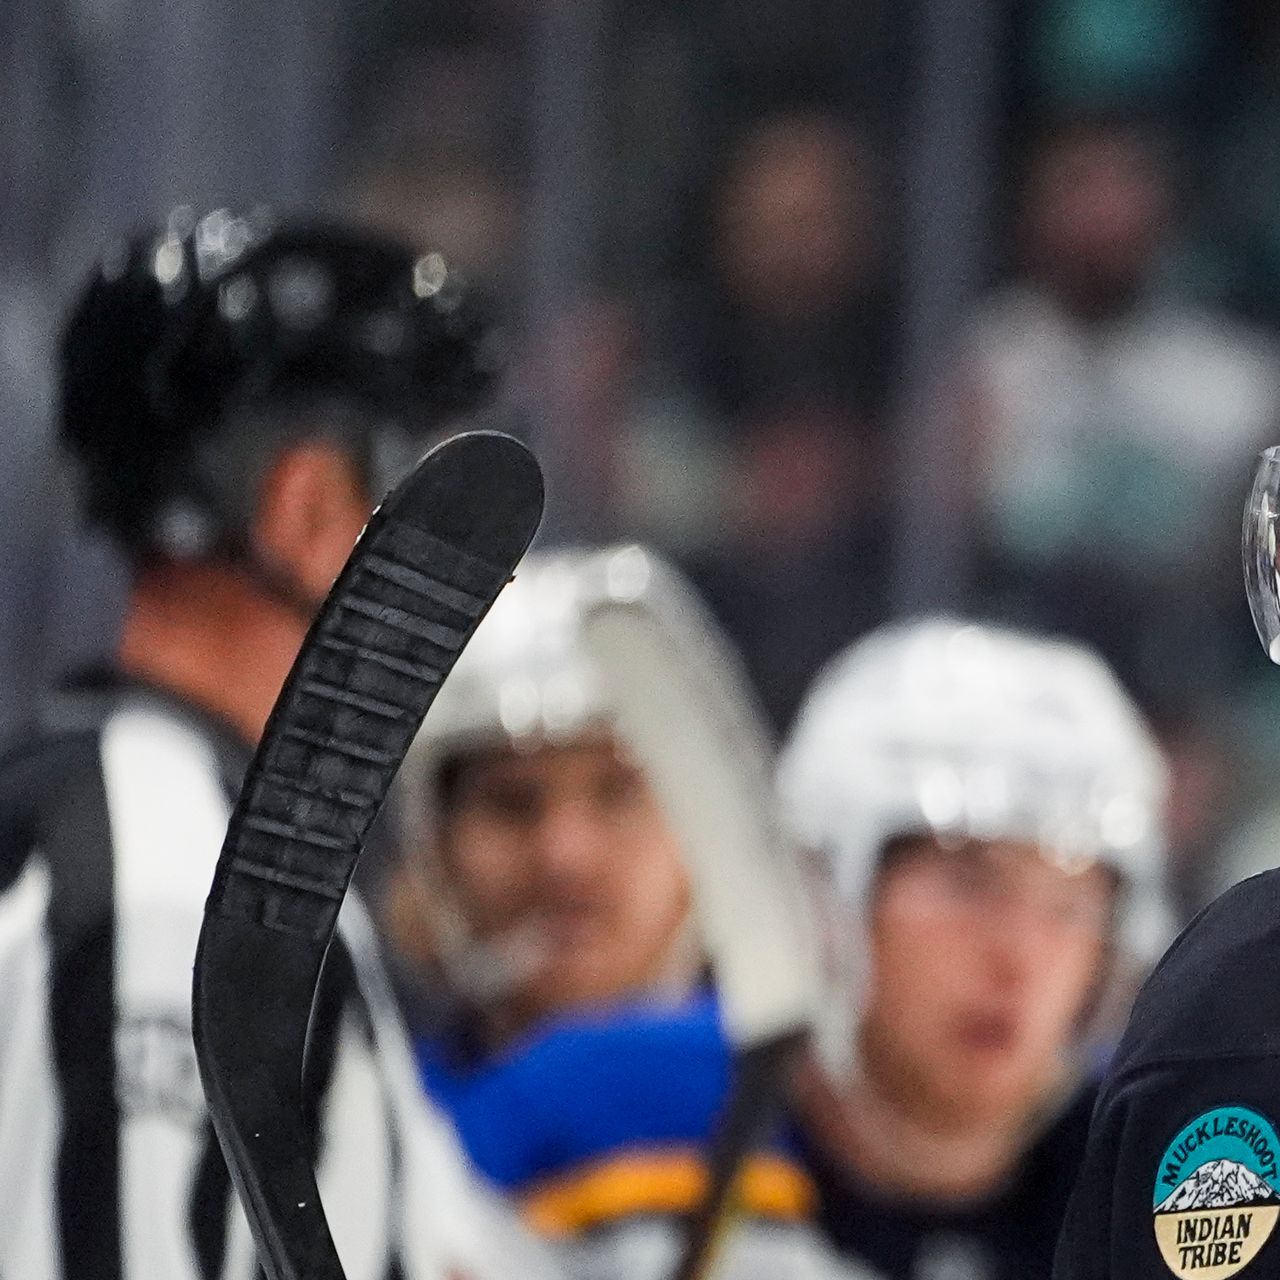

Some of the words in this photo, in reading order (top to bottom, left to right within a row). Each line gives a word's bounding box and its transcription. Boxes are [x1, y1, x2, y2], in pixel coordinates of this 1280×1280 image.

[1162, 1117, 1277, 1187] MUCKLESHOOT
[1176, 1213, 1253, 1245] INDIAN
[1178, 1241, 1244, 1270] TRIBE
